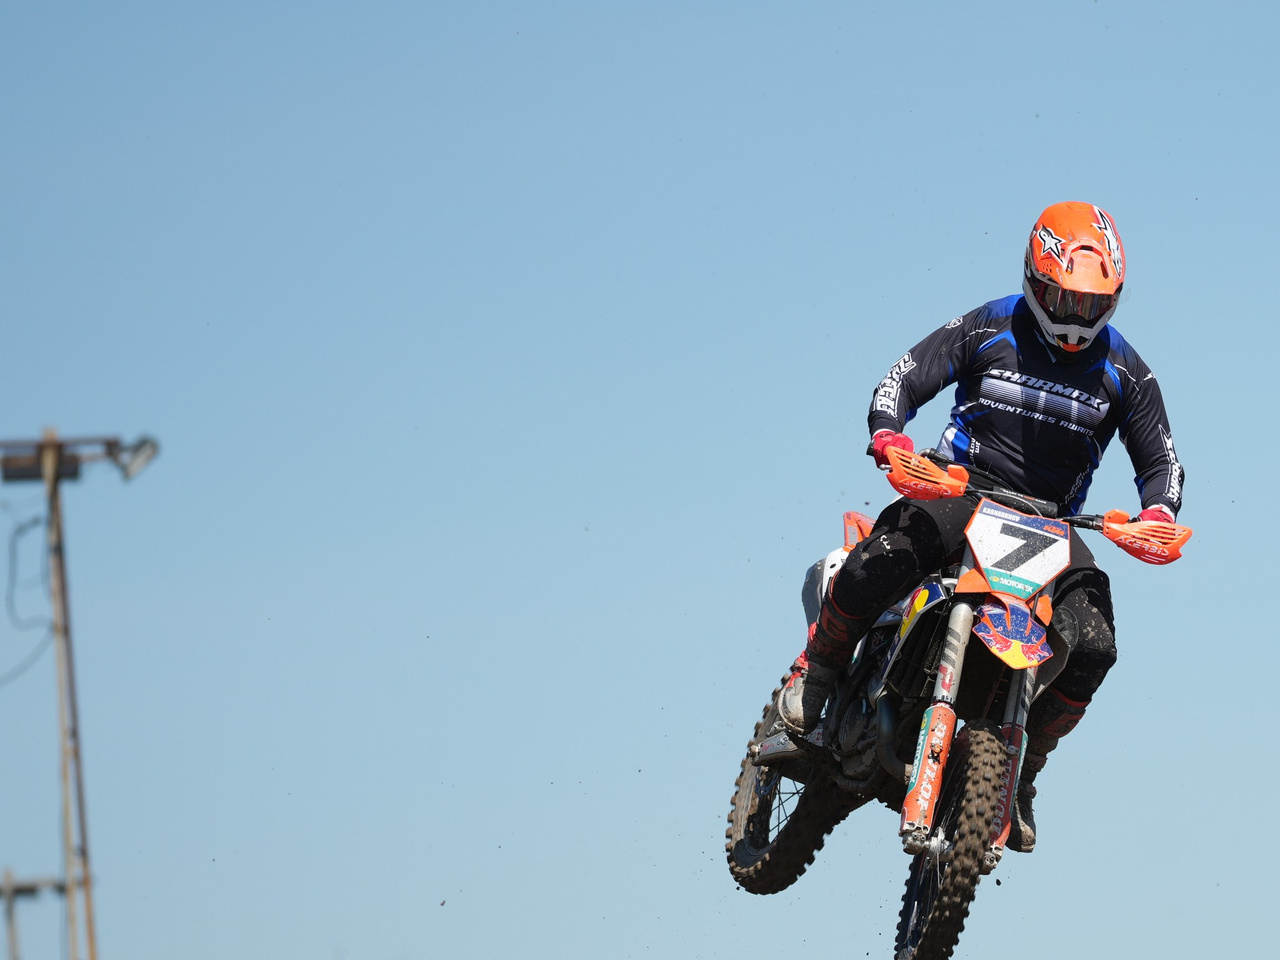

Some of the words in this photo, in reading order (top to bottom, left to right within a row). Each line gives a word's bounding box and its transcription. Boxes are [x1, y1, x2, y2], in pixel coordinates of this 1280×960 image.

[987, 366, 1107, 413] SHARMAX
[978, 397, 1057, 425] ADVENTURES
[1059, 419, 1095, 437] AWAITS
[990, 522, 1060, 573] 7
[999, 577, 1034, 593] MOTOREX
